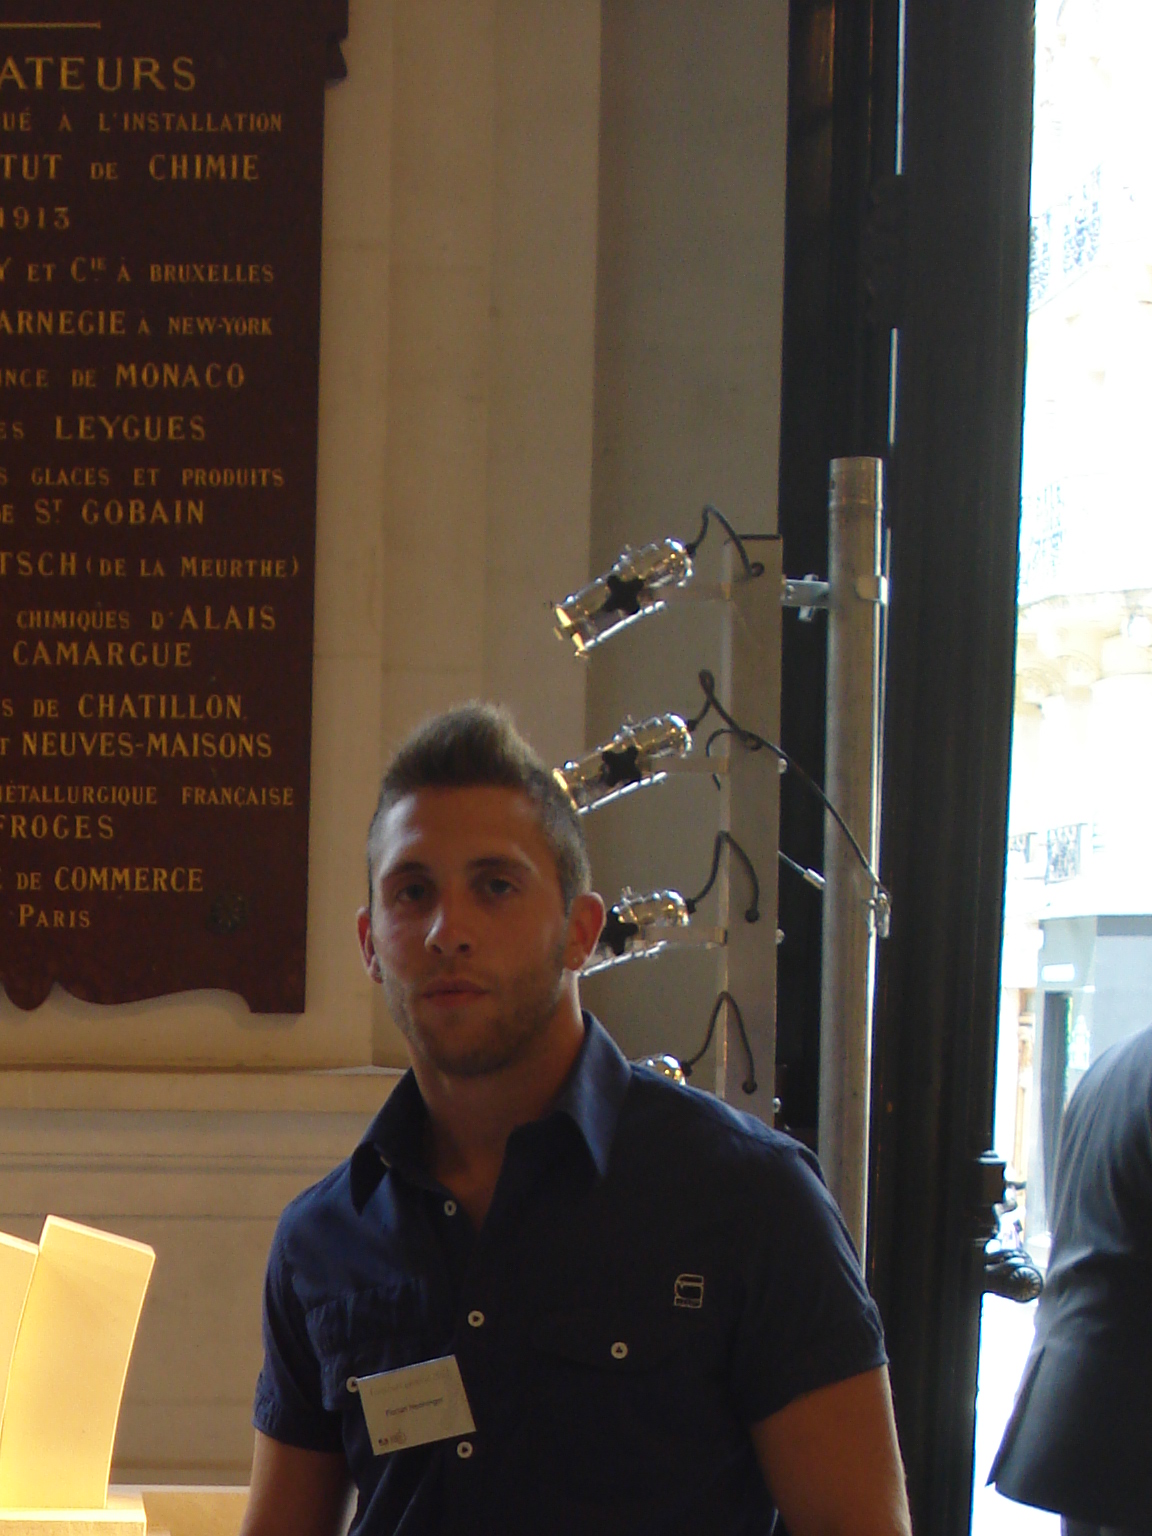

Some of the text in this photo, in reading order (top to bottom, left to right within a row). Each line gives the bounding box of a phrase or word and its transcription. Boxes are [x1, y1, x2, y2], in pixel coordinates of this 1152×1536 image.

[90, 162, 118, 181] DE
[148, 154, 259, 180] CHIMIE
[27, 263, 54, 282] ET
[149, 263, 274, 283] BRUXELLES
[168, 316, 272, 335] NEW-YORK
[71, 369, 96, 388] DE
[115, 363, 245, 388] MONACO
[55, 415, 205, 441] LEYGUES
[30, 467, 110, 487] GLACES
[133, 467, 159, 487] ET
[182, 468, 284, 487] PRODUITS
[81, 499, 204, 525] GOBAIN
[139, 558, 165, 577] LA
[16, 610, 130, 632] CHIMIQUES
[12, 640, 191, 667] CAMARGUE
[33, 698, 59, 718] DE
[22, 731, 272, 758] NEUVES-MAISONS
[181, 786, 294, 807] FRANÇAISE
[16, 872, 41, 891] DE
[54, 867, 202, 892] COMMERCE
